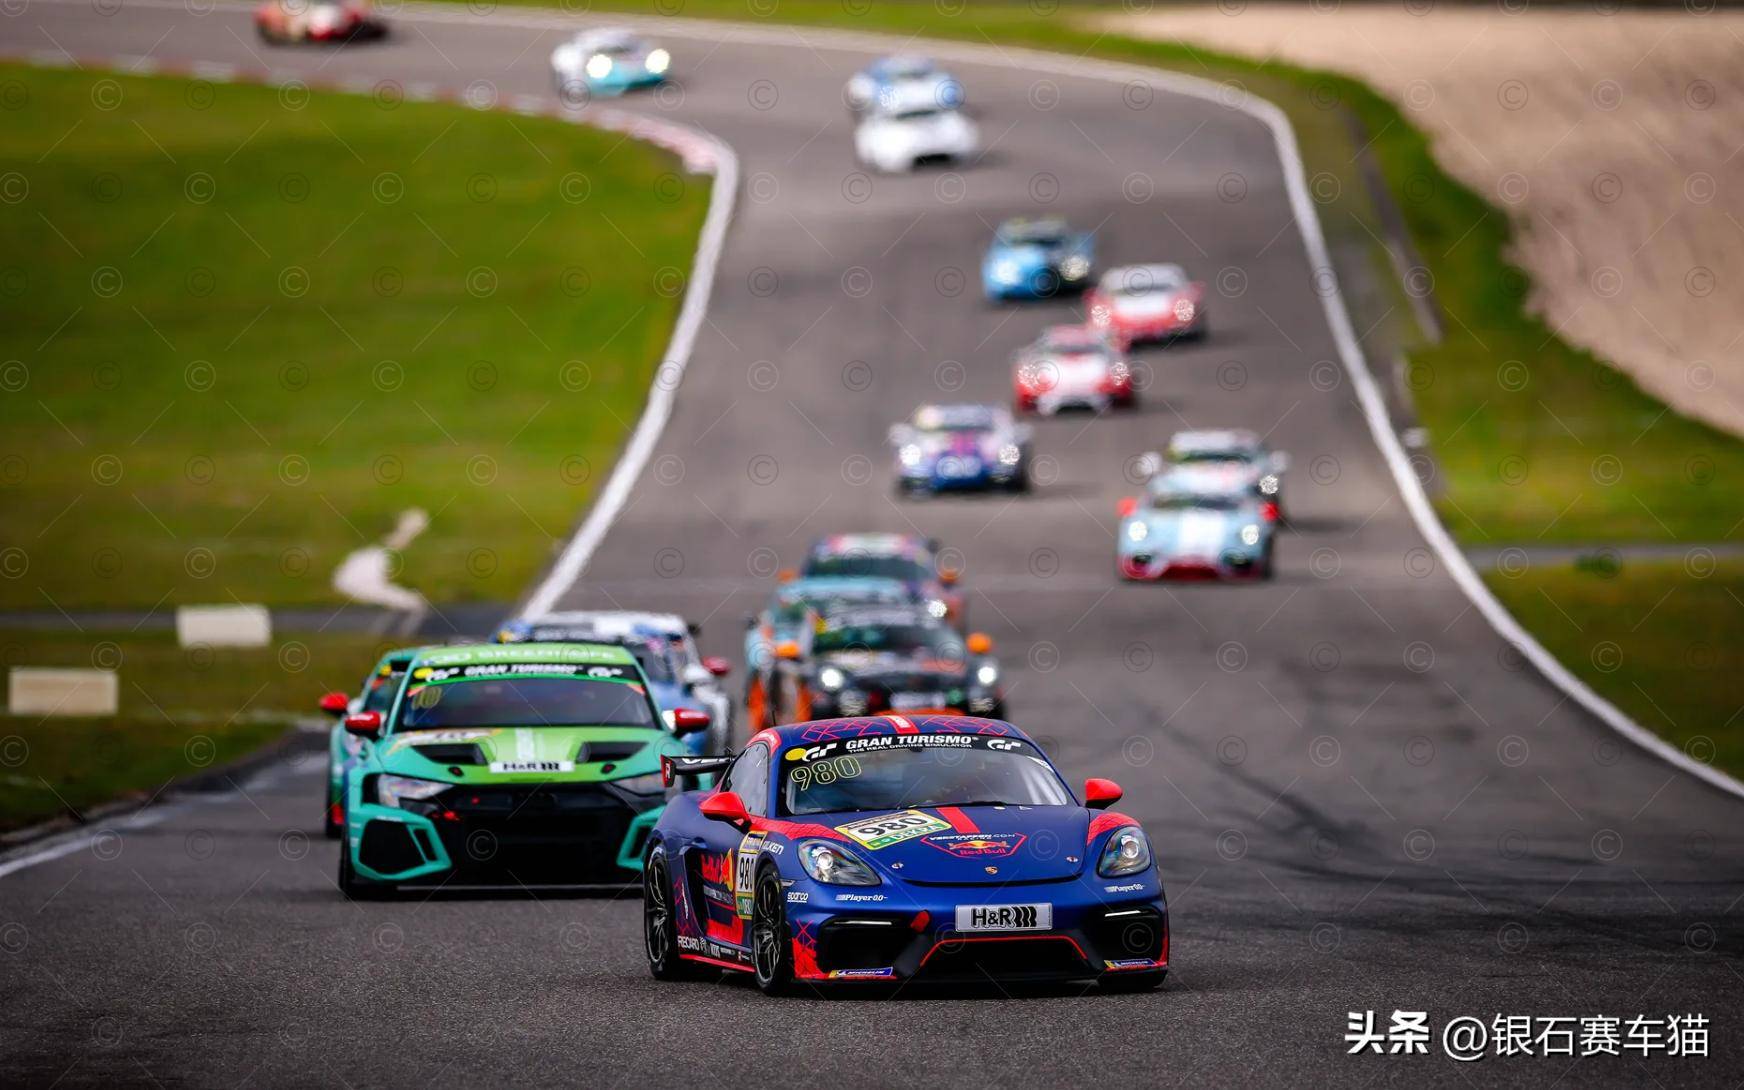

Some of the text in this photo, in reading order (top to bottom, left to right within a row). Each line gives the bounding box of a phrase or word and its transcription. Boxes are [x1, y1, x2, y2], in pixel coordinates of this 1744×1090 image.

[846, 735, 973, 750] GRAN TURISMO
[791, 755, 861, 791] 980
[858, 818, 928, 835] 980
[971, 907, 1014, 928] H&R
